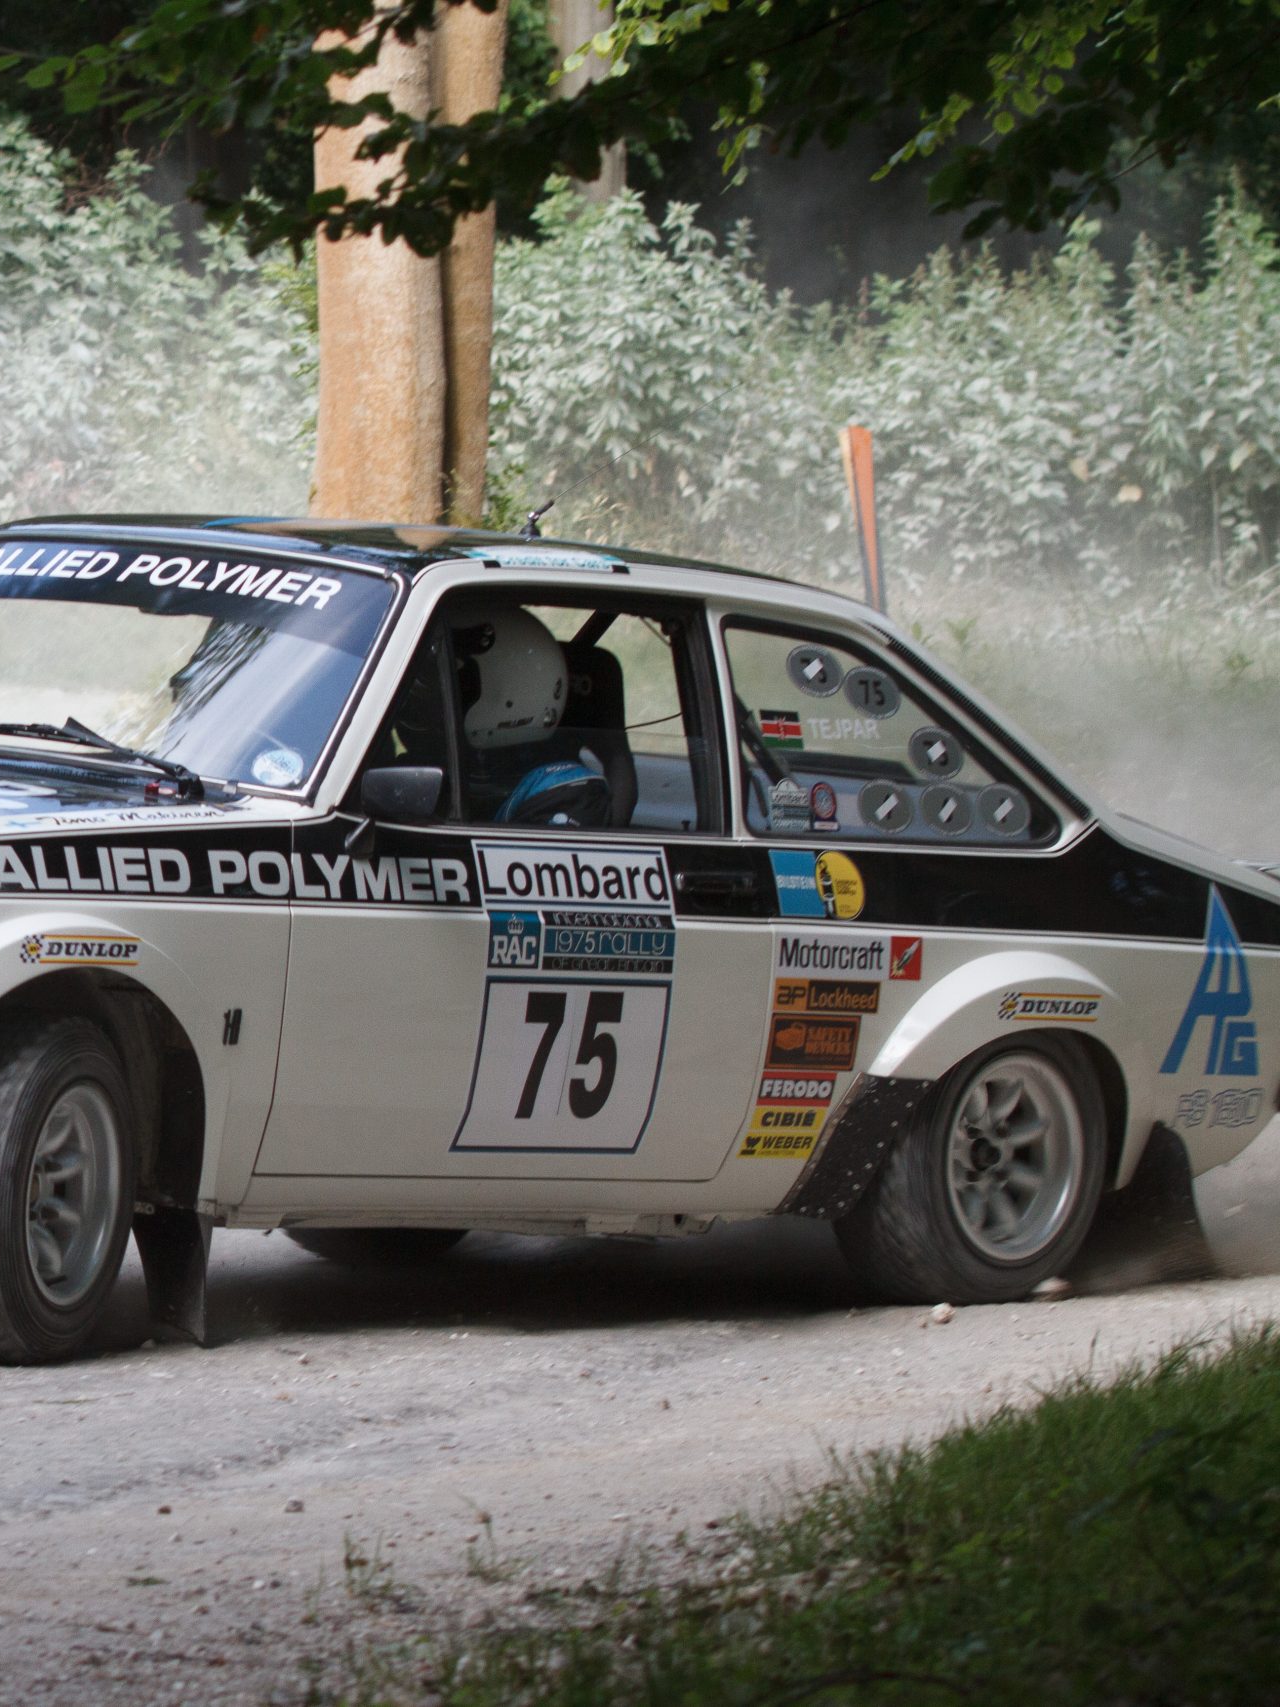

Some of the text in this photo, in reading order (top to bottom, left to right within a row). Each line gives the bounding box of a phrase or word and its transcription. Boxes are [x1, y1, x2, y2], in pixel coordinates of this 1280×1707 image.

[116, 554, 343, 610] POLYMER
[858, 679, 885, 706] 75
[807, 718, 880, 740] TEJPAR
[208, 849, 472, 904] POLYMER
[477, 850, 670, 901] Lombard
[46, 942, 138, 957] DUNLOP
[491, 935, 537, 966] RAC
[555, 930, 596, 954] 1975
[779, 938, 885, 971] Motorcraft
[810, 987, 878, 1009] Lockheed
[1018, 999, 1098, 1015] DUNLOP
[514, 991, 625, 1120] 75
[760, 1079, 833, 1098] FERODO
[761, 1136, 814, 1149] WEBER
